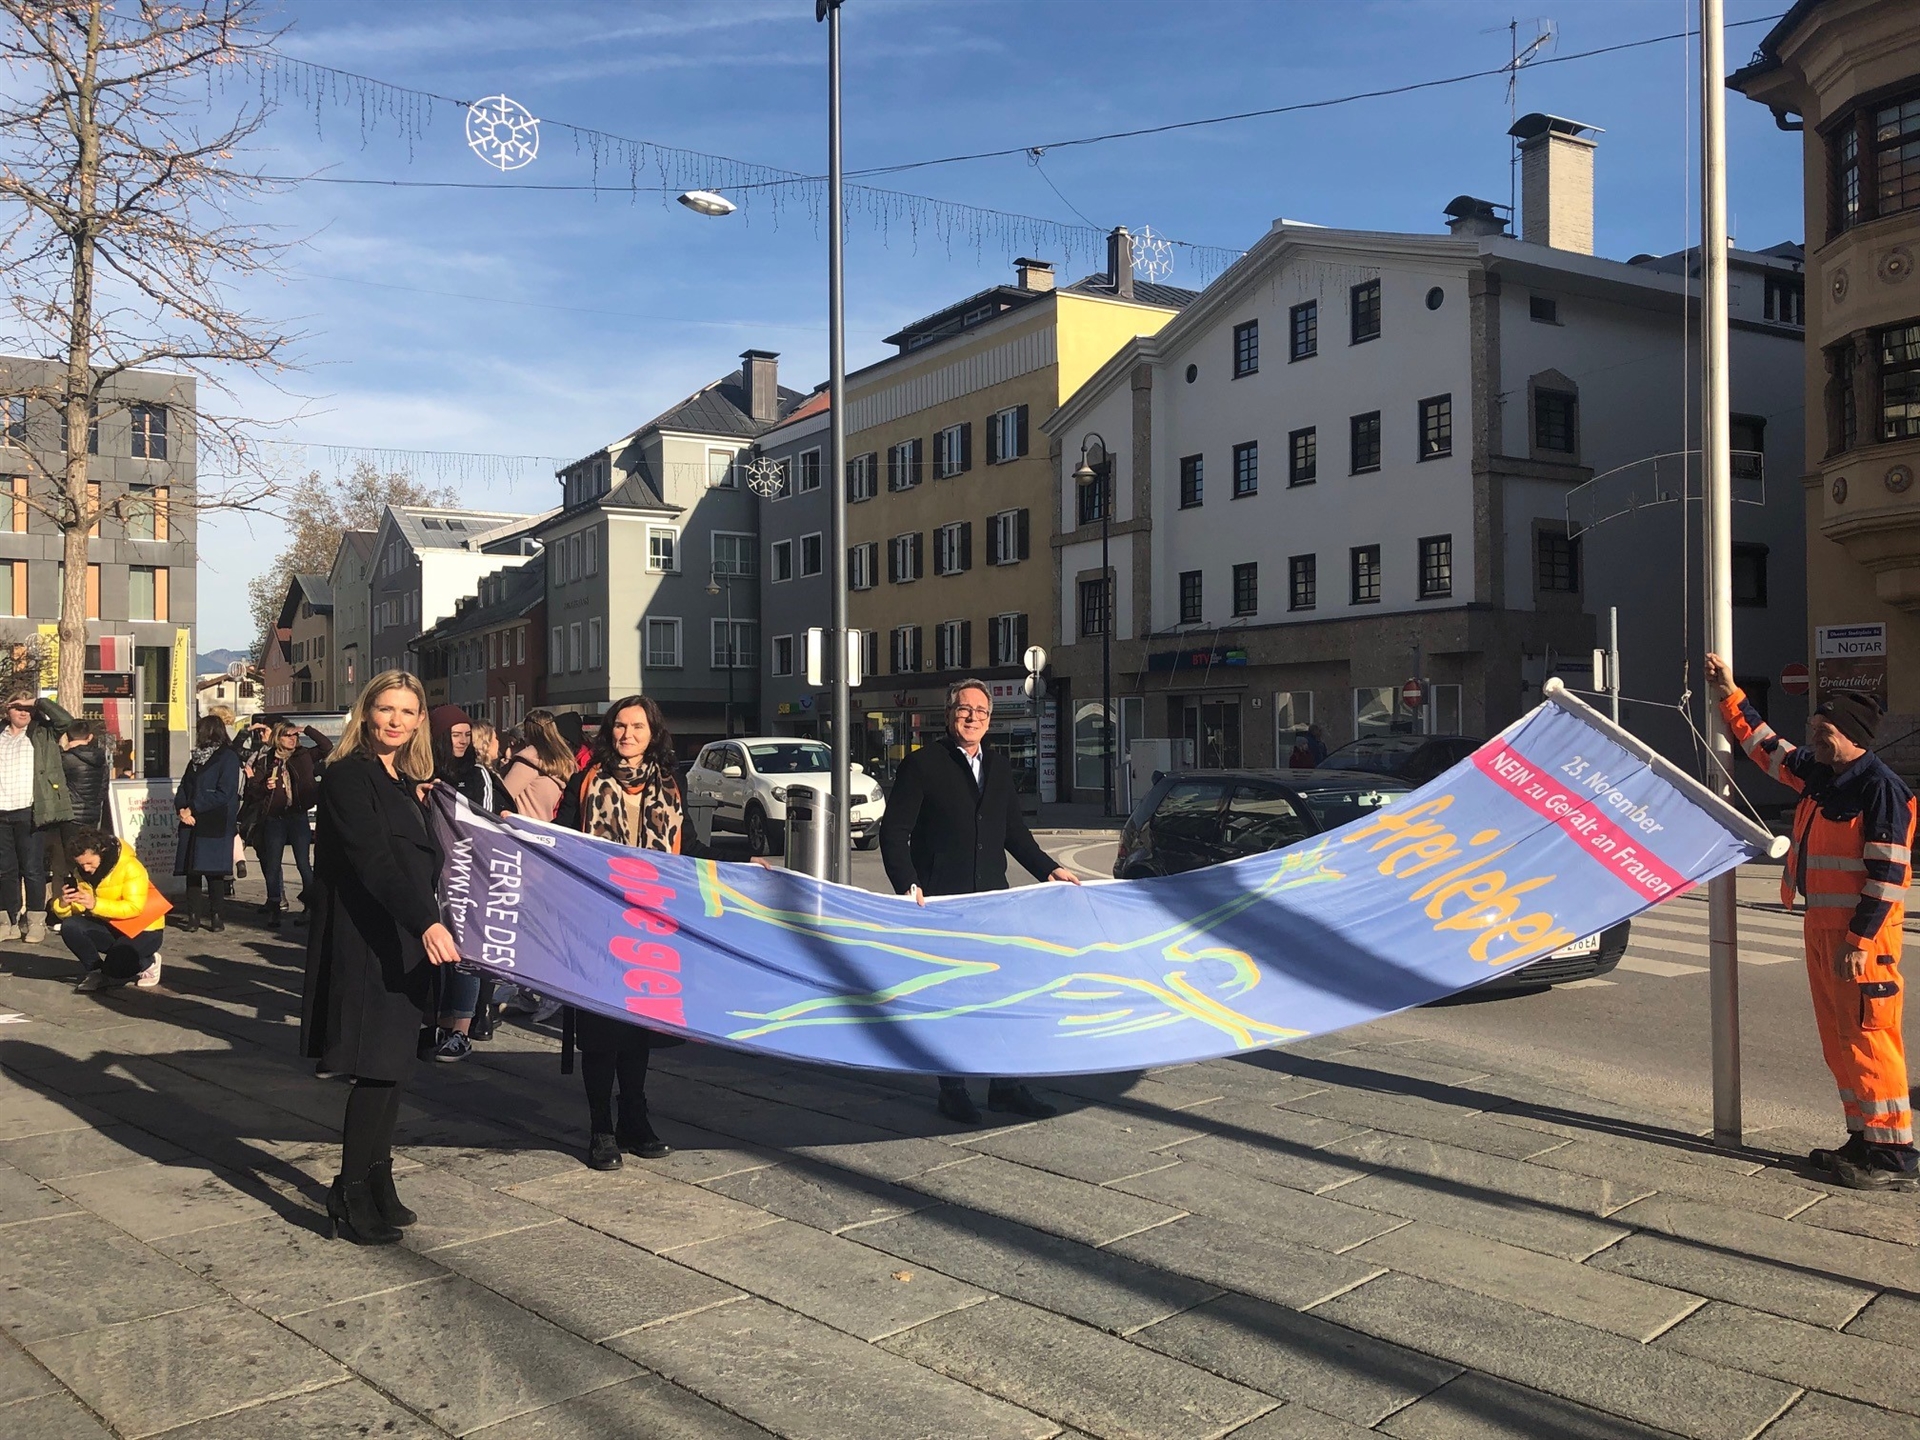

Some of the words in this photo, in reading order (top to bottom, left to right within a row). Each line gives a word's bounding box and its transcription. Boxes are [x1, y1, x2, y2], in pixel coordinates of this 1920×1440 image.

[1193, 654, 1210, 665] BTV
[1838, 642, 1882, 653] NOTAR
[1819, 673, 1884, 688] Bräustüberl
[1560, 755, 1590, 780] 25.
[1488, 751, 1535, 787] NEIN
[1524, 782, 1549, 801] zu
[1591, 833, 1616, 853] an
[1611, 846, 1672, 897] Frauen
[485, 848, 522, 924] TERRE
[482, 924, 517, 968] DES
